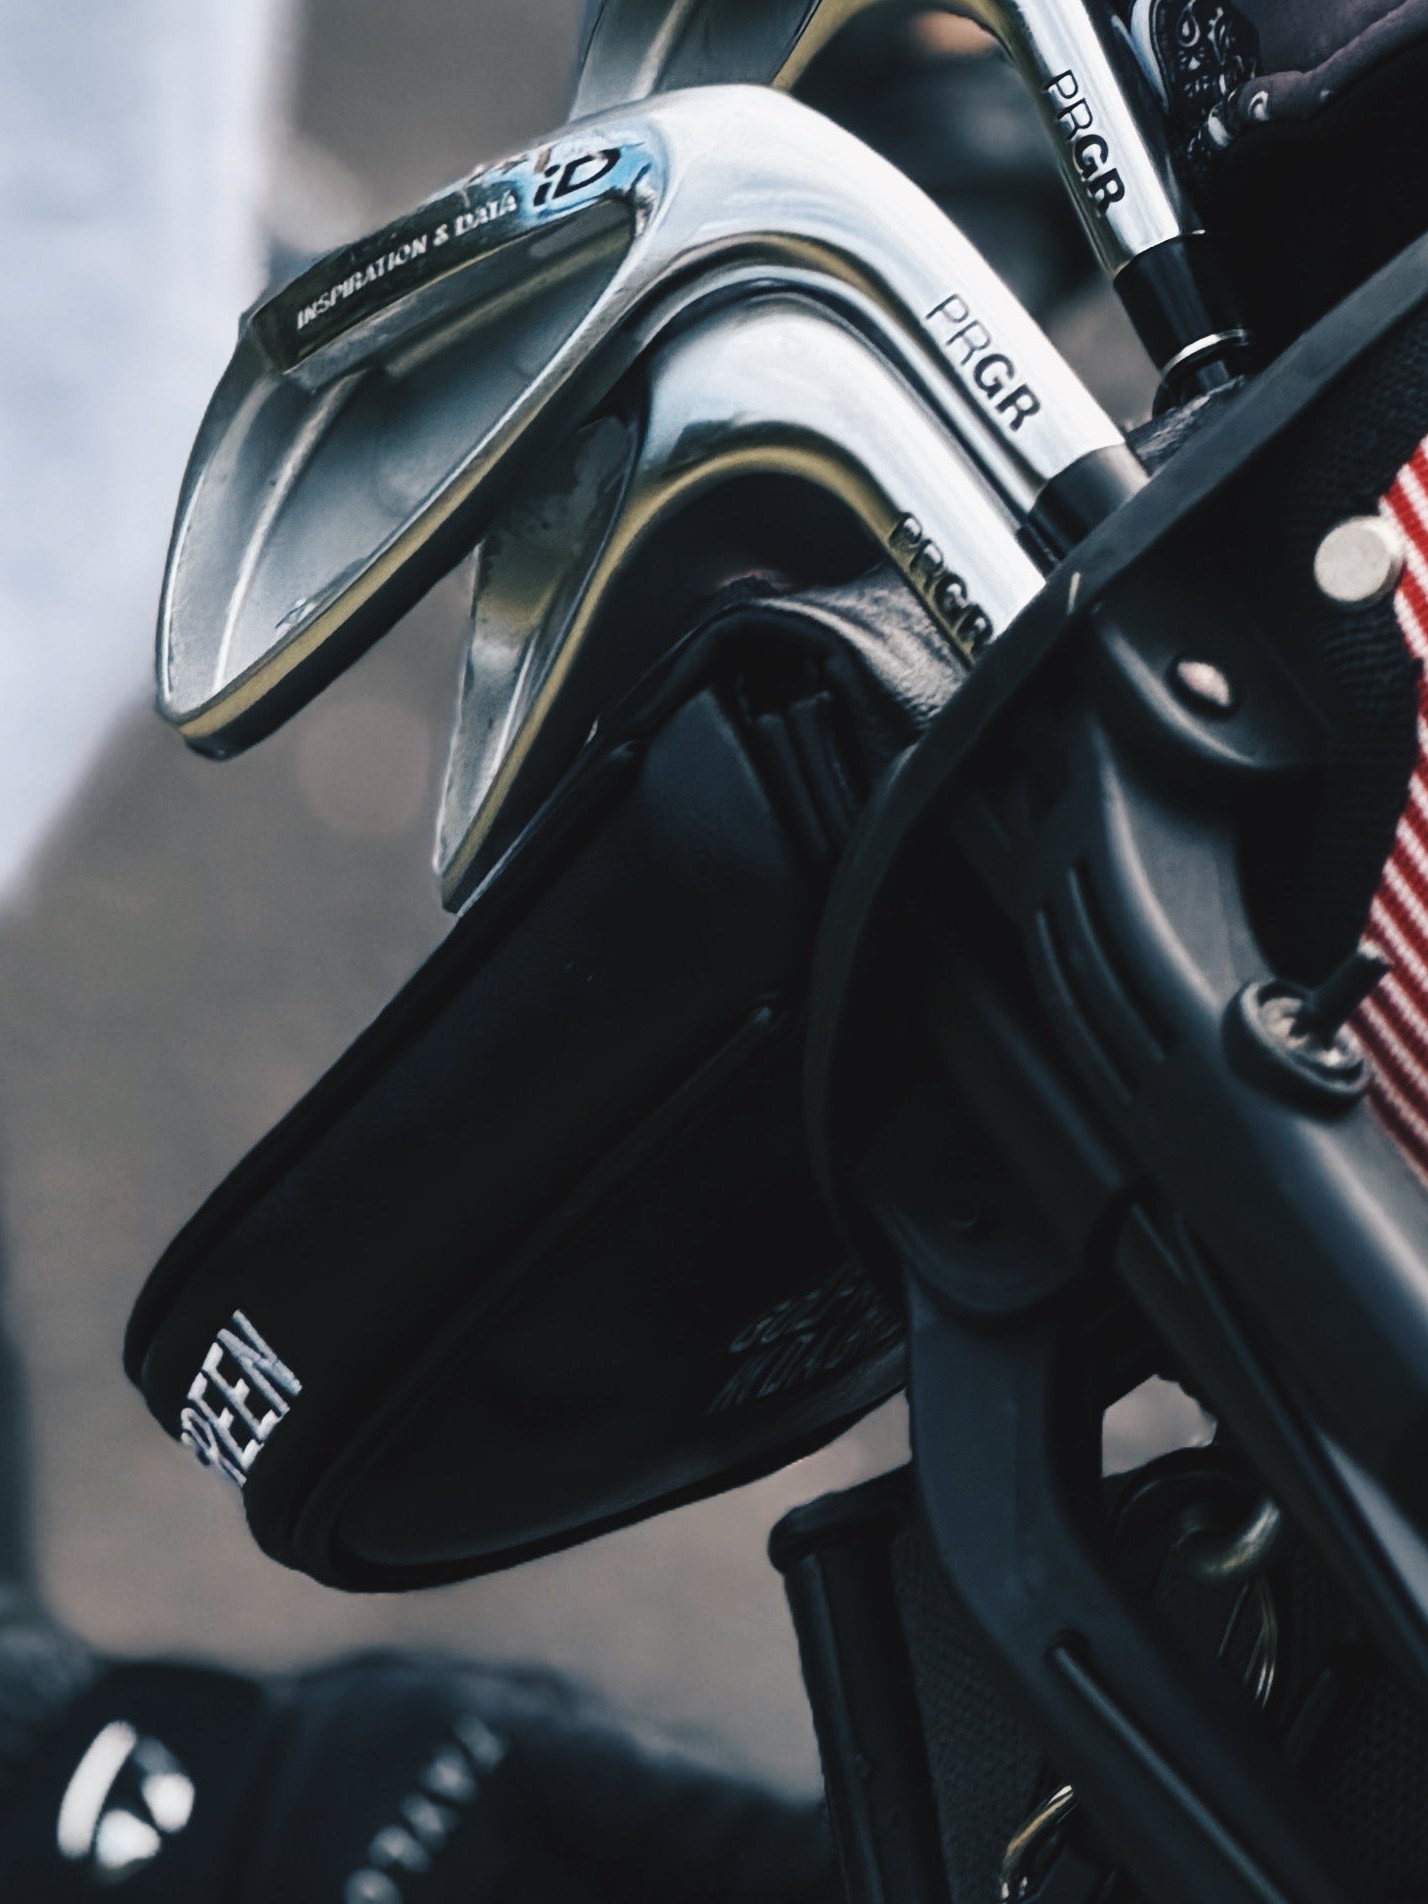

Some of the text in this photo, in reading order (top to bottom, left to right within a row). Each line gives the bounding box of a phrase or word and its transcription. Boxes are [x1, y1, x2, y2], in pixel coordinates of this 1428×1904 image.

[1042, 68, 1128, 218] PRGR
[296, 233, 428, 331] INSPIRATION
[454, 190, 518, 237] DATA
[924, 292, 1042, 433] PRGR
